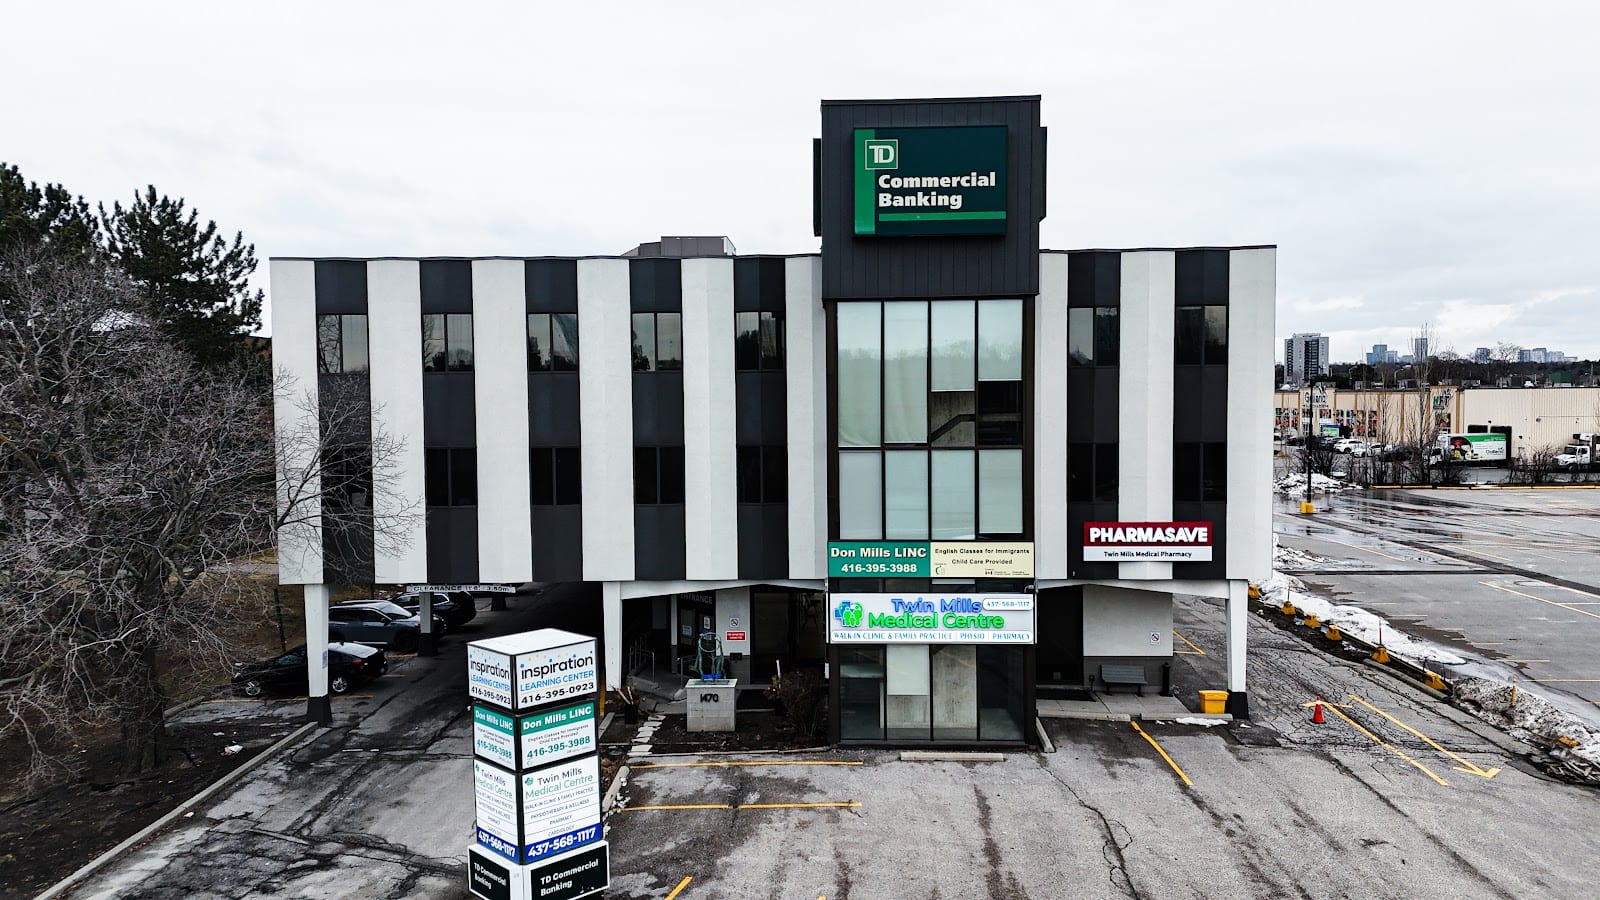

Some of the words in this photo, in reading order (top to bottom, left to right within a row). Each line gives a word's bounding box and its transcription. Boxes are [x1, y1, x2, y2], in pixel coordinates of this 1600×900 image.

[868, 145, 894, 164] TD
[878, 172, 996, 188] Commercial
[878, 192, 962, 210] Banking
[1089, 527, 1208, 542] PHARMASAVE
[831, 548, 856, 558] Don
[860, 548, 890, 558] Mills
[894, 548, 927, 558] LINC
[840, 564, 917, 573] 416-395-3988
[891, 598, 934, 612] Twin
[940, 598, 982, 612] Mills
[868, 612, 938, 628] Medical
[942, 613, 1004, 628] Centre
[992, 632, 1030, 640] PHARMACY
[470, 655, 510, 680] inspiration
[520, 656, 593, 680] inspiration
[471, 675, 492, 688] LEARNING
[492, 681, 510, 692] CENTER
[520, 676, 562, 692] LEARNING
[564, 670, 594, 683] CENTER
[471, 686, 511, 705] 416-395-0923
[522, 682, 594, 704] 416-395-0923
[700, 693, 719, 703] 1470
[475, 710, 486, 720] Don
[486, 714, 498, 726] Mills
[500, 719, 512, 730] LINC
[523, 721, 542, 730] Don
[544, 714, 566, 724] Mills
[569, 706, 592, 718] LINC
[561, 732, 578, 740] Provided
[527, 736, 590, 758] 416-395-3988
[481, 770, 492, 779] Twin
[494, 774, 506, 786] Mills
[537, 774, 560, 786] Twin
[562, 768, 582, 778] Mills
[476, 777, 494, 792] Medical
[495, 784, 512, 799] Centre
[526, 782, 562, 800] Medical
[564, 774, 593, 788] Centre
[560, 792, 575, 800] FAMILY
[576, 786, 594, 796] PRACTICE
[530, 806, 564, 820] PHYSIOTHERAPY
[568, 798, 590, 808] WELLNESS
[550, 815, 572, 825] PHARMACY
[548, 825, 574, 836] CARDIOLOGY
[478, 830, 516, 858] 437-568-1117
[528, 827, 596, 857] 437-568-1117
[474, 862, 480, 871] TD
[480, 864, 506, 886] Commercial
[540, 876, 552, 885] TD
[552, 858, 598, 880] Commercial
[474, 874, 492, 890] Banking
[540, 880, 572, 896] Banking
